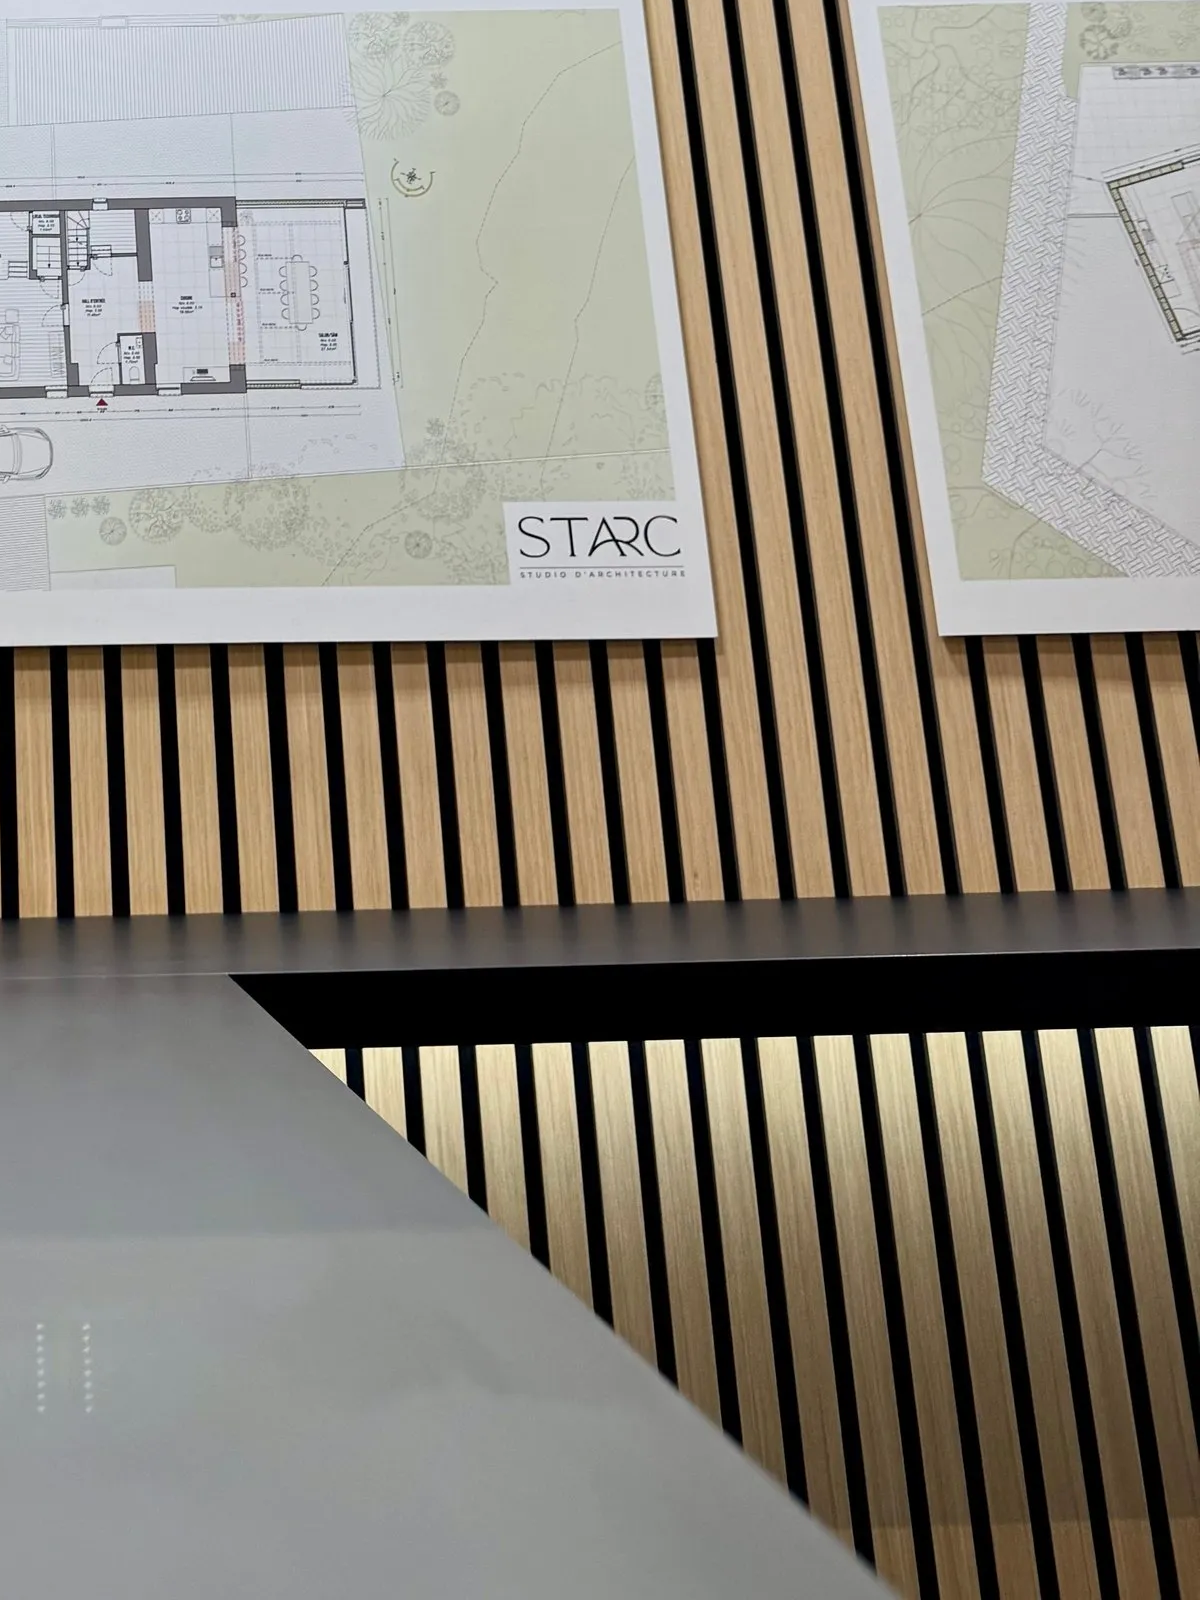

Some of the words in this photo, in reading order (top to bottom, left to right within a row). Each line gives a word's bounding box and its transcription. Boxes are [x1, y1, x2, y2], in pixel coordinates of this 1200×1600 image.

[517, 515, 682, 558] STARC
[519, 570, 567, 579] STUDIO
[574, 569, 687, 578] D'ARCHITECTURE
